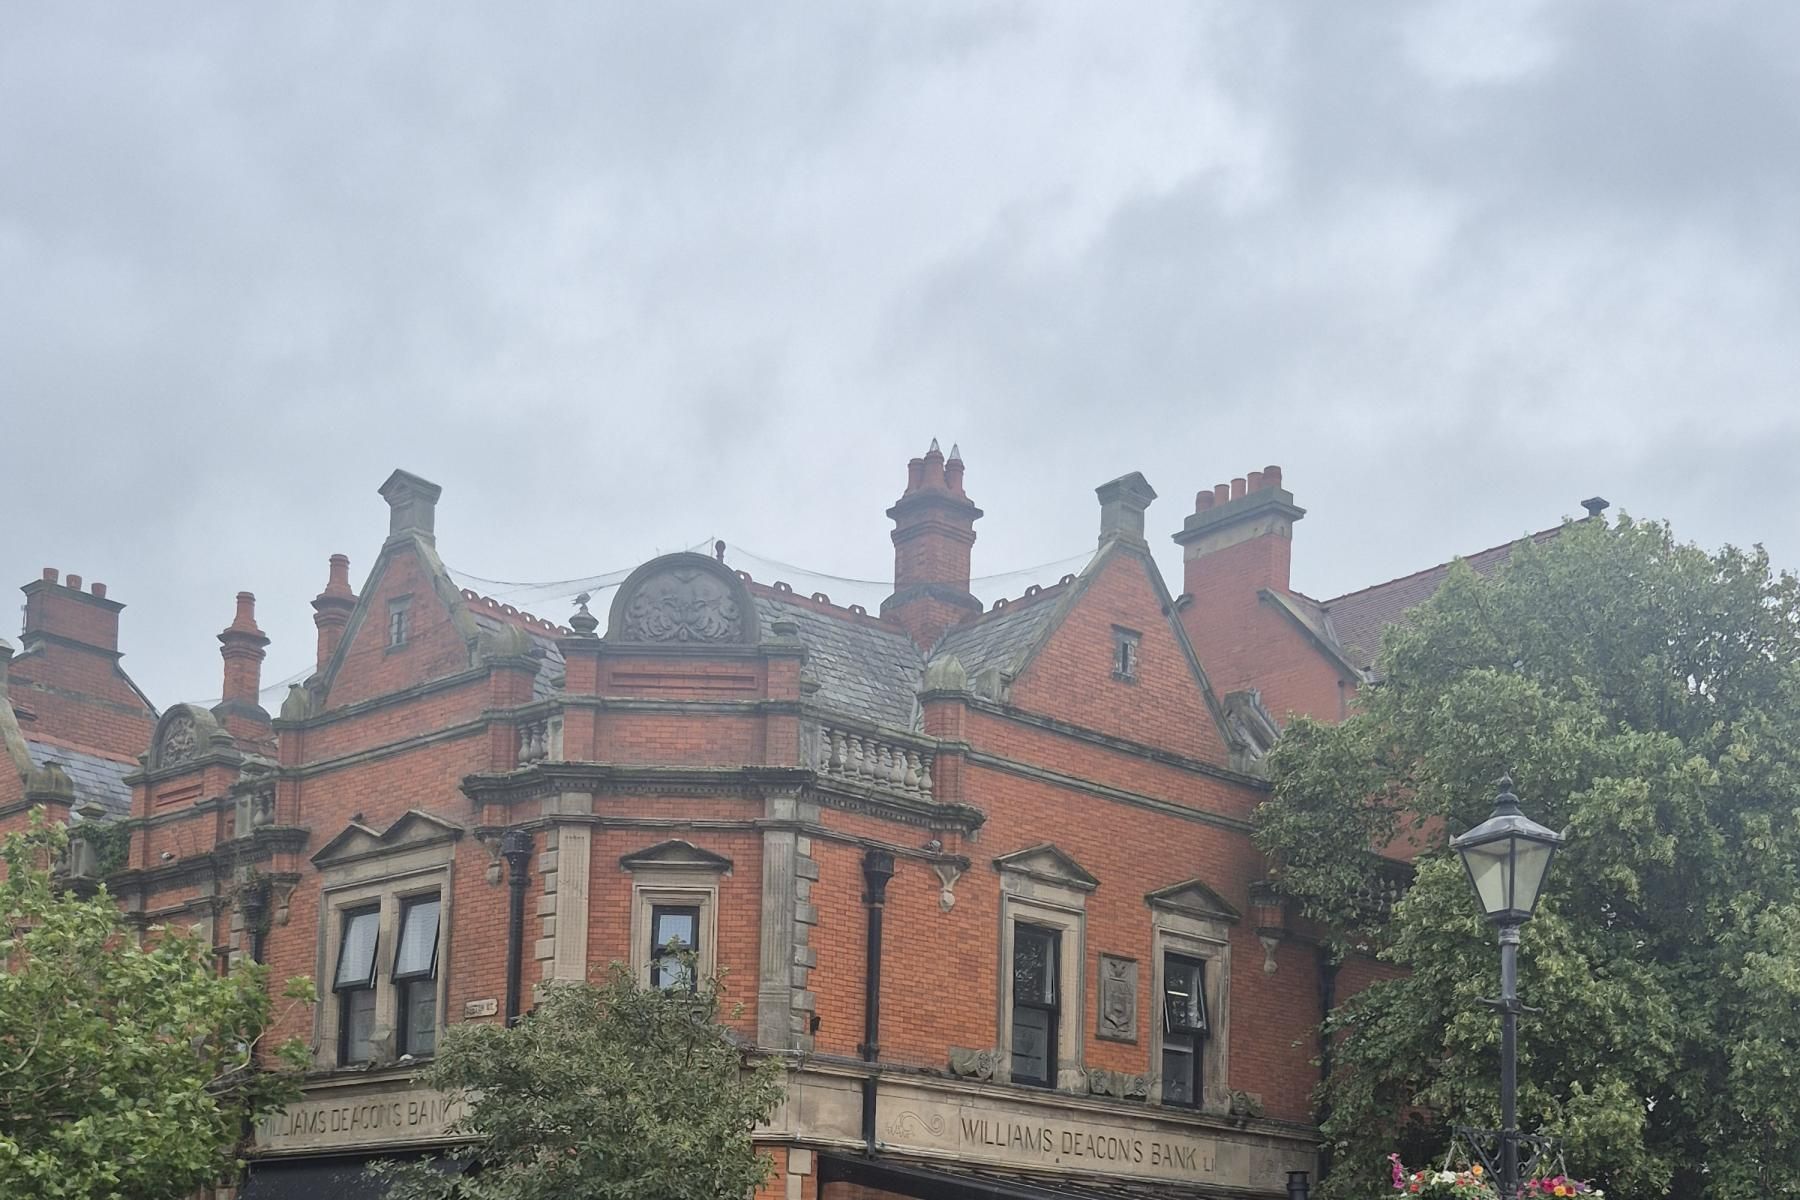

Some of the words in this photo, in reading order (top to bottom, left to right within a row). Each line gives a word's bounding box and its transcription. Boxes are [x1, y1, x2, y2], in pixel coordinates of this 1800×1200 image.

[961, 1117, 1053, 1153] WILLIAMS
[1061, 1131, 1143, 1164] DEACON'S
[1151, 1142, 1198, 1172] BANK
